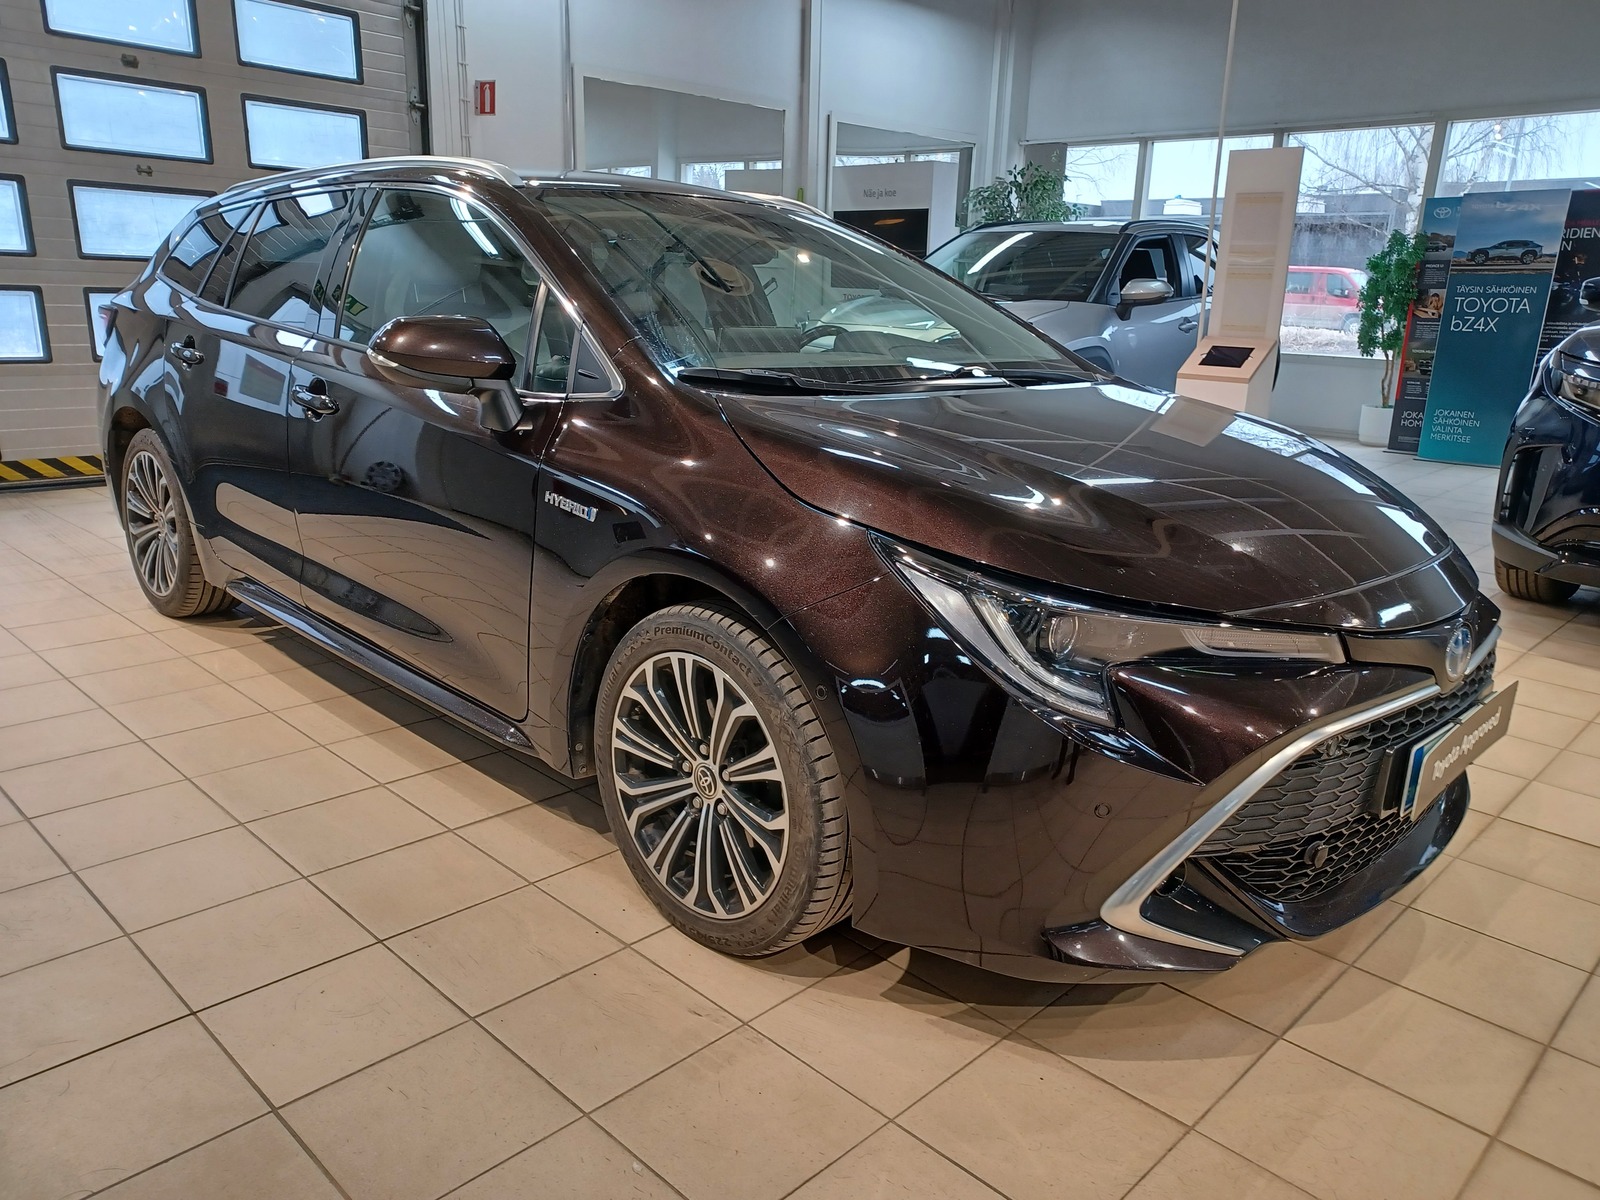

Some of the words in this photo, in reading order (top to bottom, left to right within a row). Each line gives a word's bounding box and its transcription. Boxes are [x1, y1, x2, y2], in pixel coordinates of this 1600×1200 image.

[863, 188, 876, 198] Näe
[877, 189, 884, 200] ja
[885, 188, 897, 198] koe
[1456, 285, 1484, 294] TÄYSIN
[1486, 285, 1537, 294] SÄHKÖINEN
[1454, 297, 1530, 314] TOYOTA
[1451, 315, 1500, 333] bZ4X
[1434, 409, 1475, 419] JOKAINEN
[1433, 417, 1480, 427] SÄHKÖINEN
[1431, 425, 1463, 434] VALINTA
[1430, 433, 1472, 443] MERKITSEE
[544, 491, 592, 521] HYBRID
[654, 626, 752, 678] PremiumContact
[1432, 746, 1460, 781] Toyota
[1460, 706, 1502, 756] Approved
